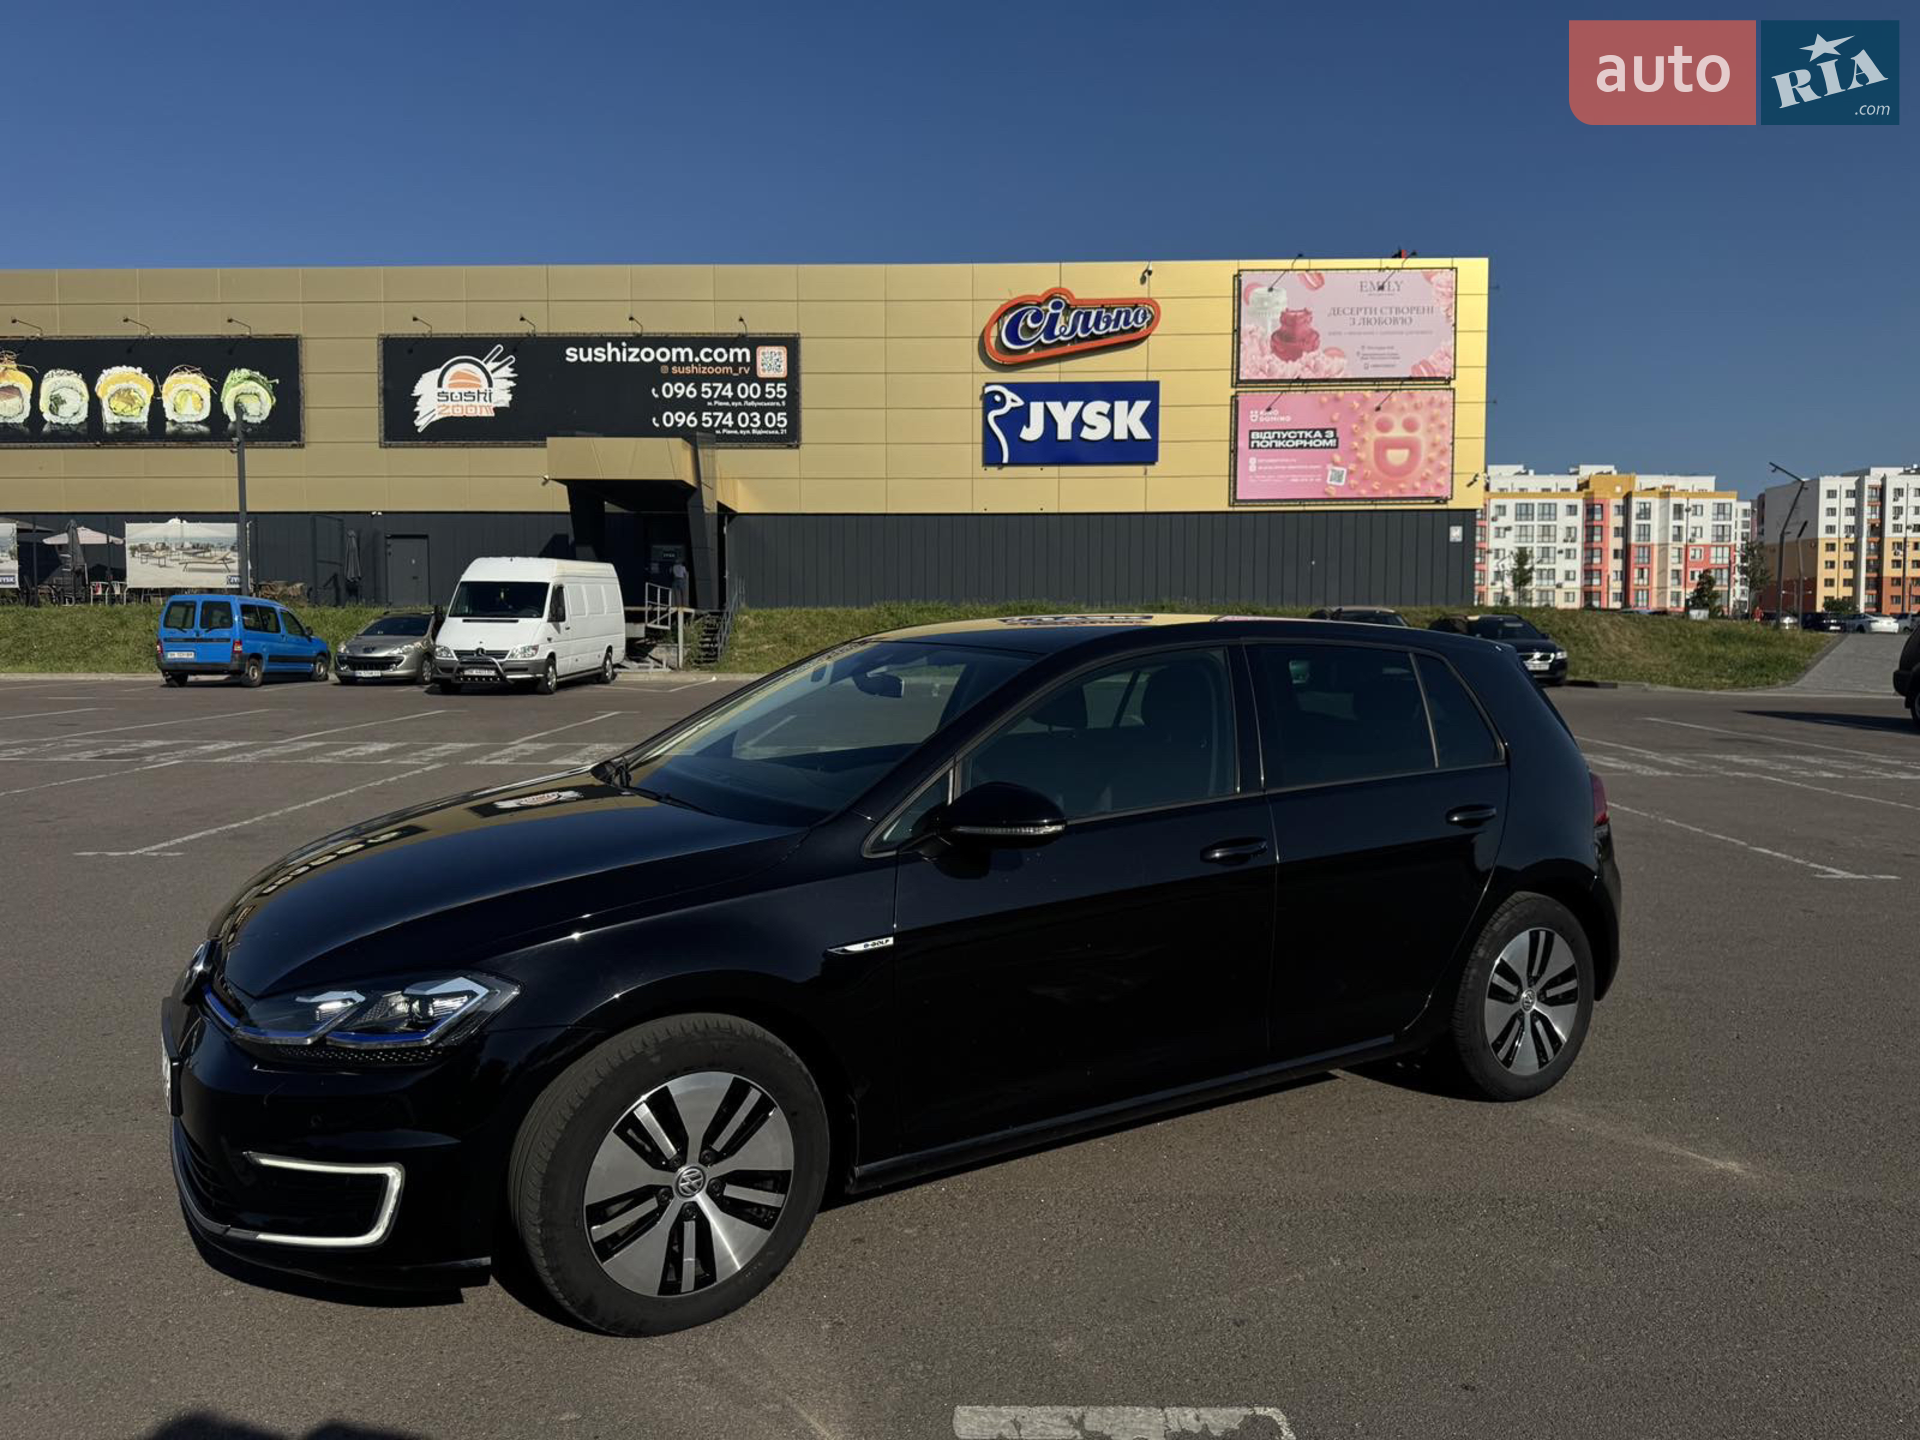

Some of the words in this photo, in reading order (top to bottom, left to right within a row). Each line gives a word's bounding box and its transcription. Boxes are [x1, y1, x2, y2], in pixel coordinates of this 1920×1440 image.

[1327, 306, 1378, 317] ДЕСЕРТИ
[1380, 305, 1435, 316] СТВОРЕНІ
[1001, 298, 1149, 350] Сільпо
[565, 341, 751, 363] sushizoom.com
[671, 363, 751, 376] sushizoom_rv
[661, 382, 698, 399] 096
[700, 382, 734, 399] 574
[736, 382, 761, 399] 00
[764, 382, 788, 399] 55
[662, 411, 699, 428] 096
[701, 411, 735, 428] 574
[737, 411, 762, 428] 03
[764, 411, 788, 428] 05
[1018, 399, 1152, 442] JYSK
[1250, 430, 1323, 440] ВІДПУСТКА
[1250, 438, 1337, 449] ПОПКОРНОМ!
